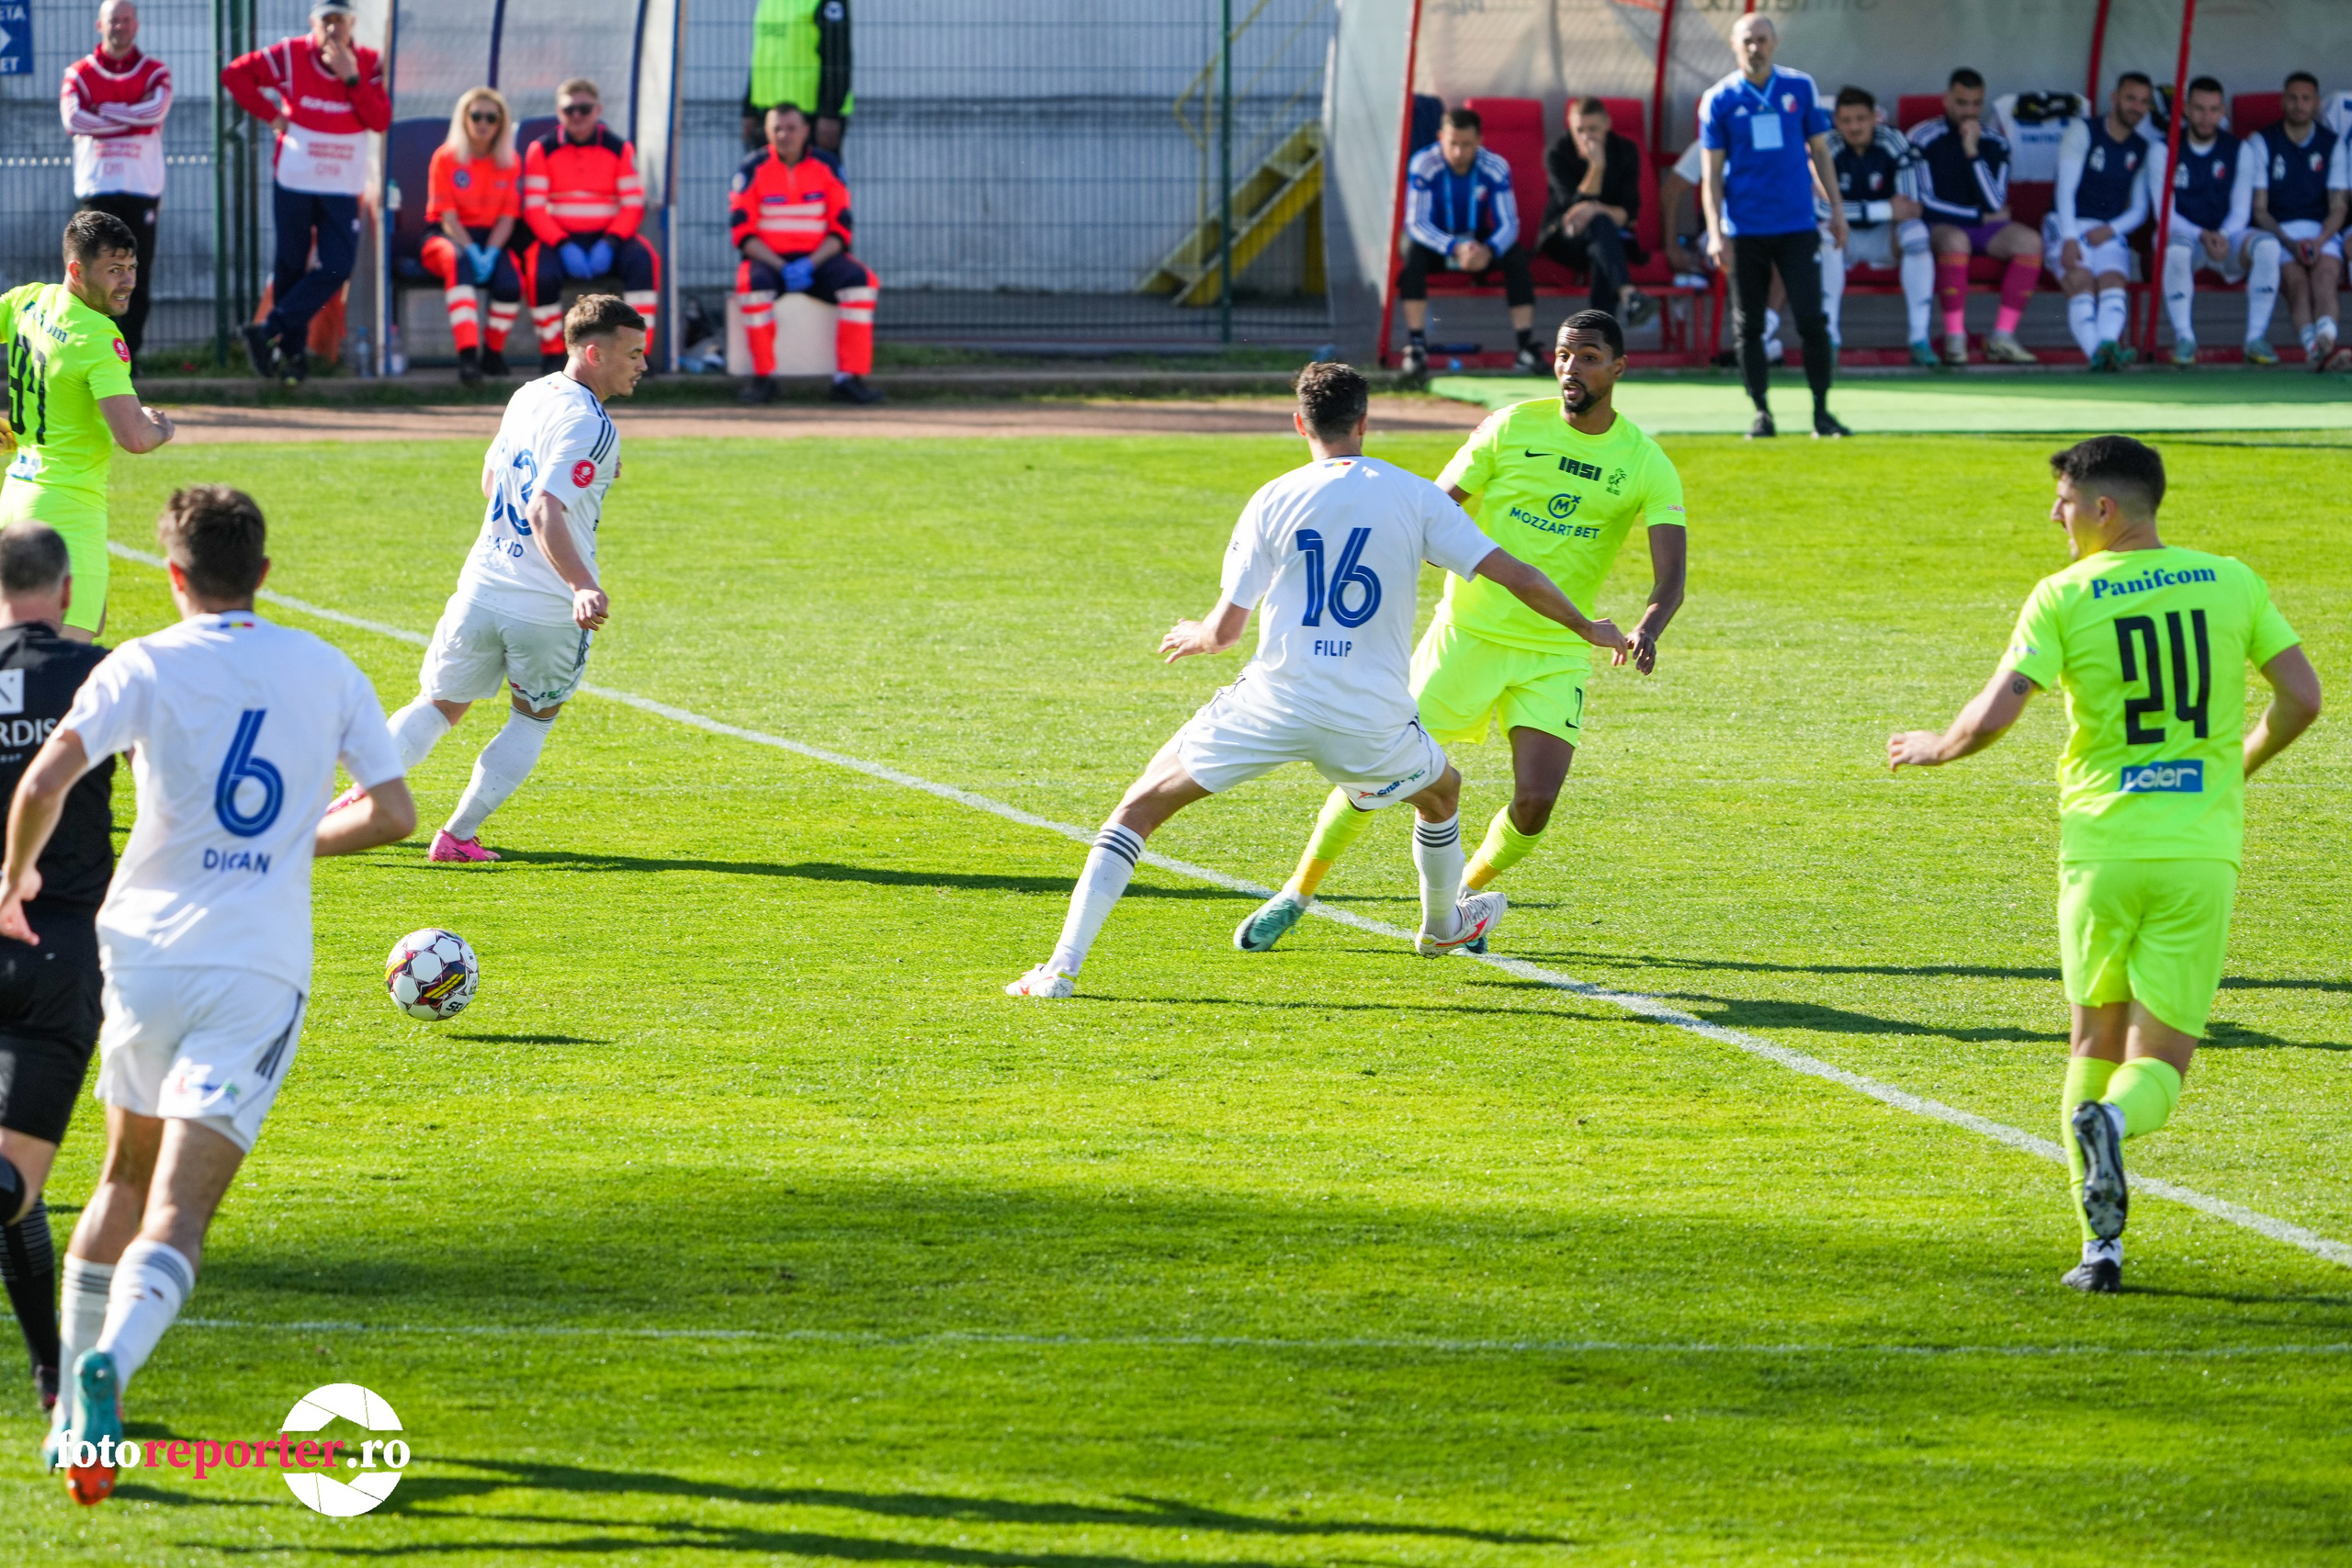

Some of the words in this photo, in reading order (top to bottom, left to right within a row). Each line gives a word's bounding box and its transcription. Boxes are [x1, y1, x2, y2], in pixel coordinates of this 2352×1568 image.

[1510, 506, 1574, 536] MOZZART
[1576, 525, 1600, 539] BET
[1296, 527, 1382, 628] 16
[2091, 568, 2217, 599] Panifcom
[1314, 640, 1352, 657] FILIP
[2114, 609, 2211, 745] 24
[215, 707, 284, 838] 6
